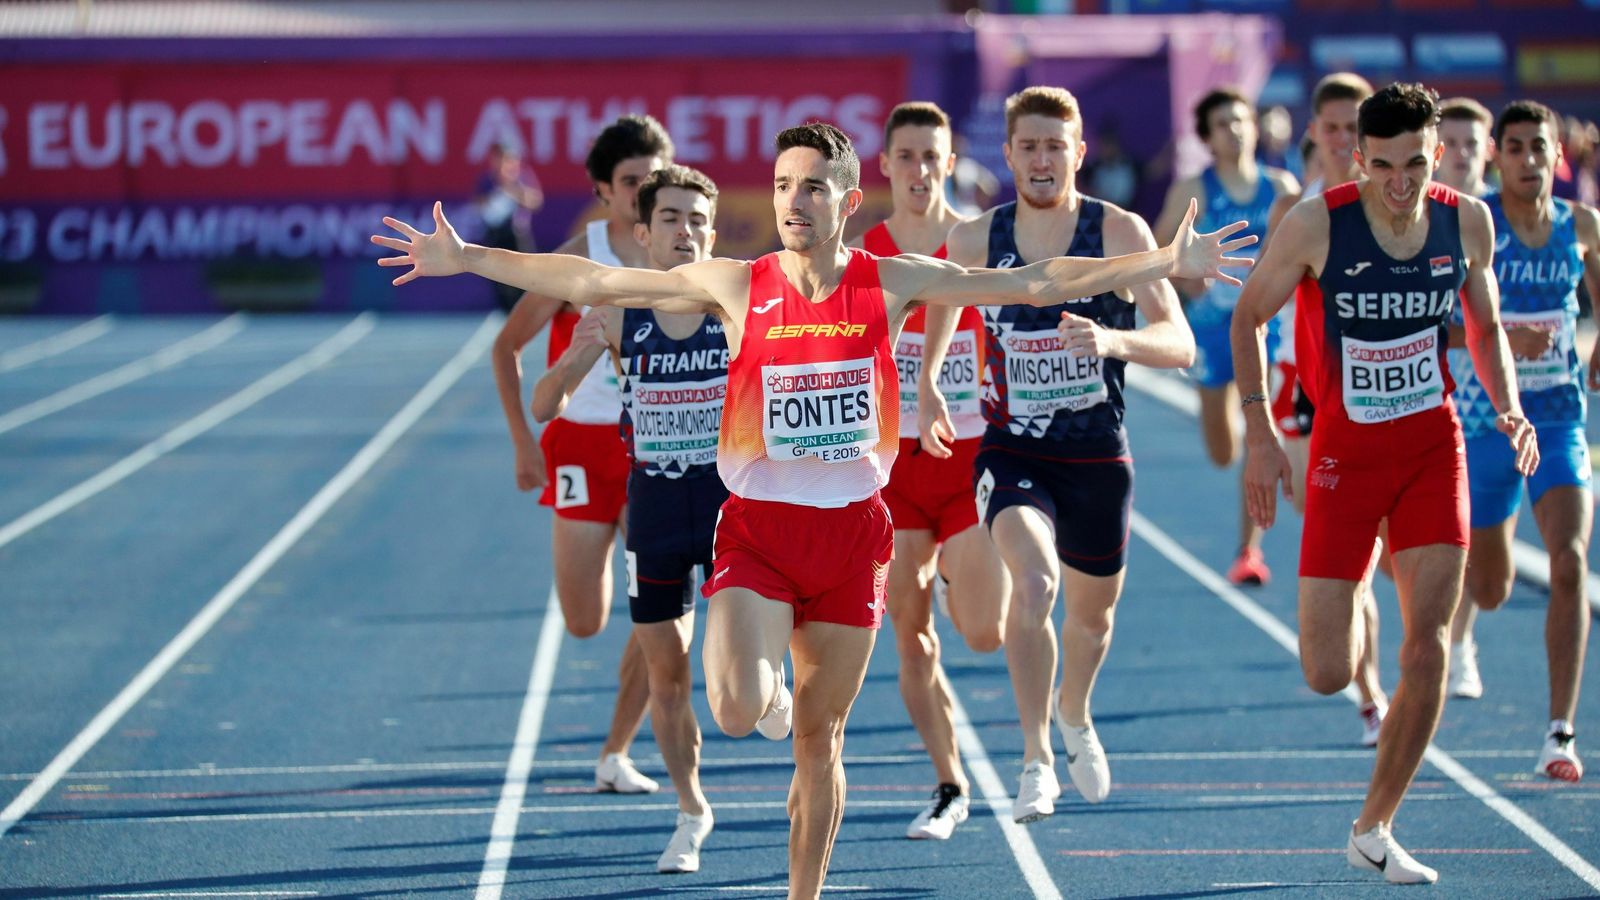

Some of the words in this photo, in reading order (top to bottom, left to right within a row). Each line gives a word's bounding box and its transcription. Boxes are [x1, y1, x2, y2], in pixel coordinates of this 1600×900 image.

[28, 101, 446, 168] EUROPEAN
[466, 94, 882, 164] ATHETIS
[1499, 260, 1569, 283] ITALIA
[1335, 288, 1455, 320] SERBIA
[765, 321, 867, 340] ESPAÑA
[901, 341, 971, 357] BAUS
[1021, 338, 1064, 352] BAUH
[1360, 335, 1434, 362] BAUHAUS
[648, 348, 730, 375] FRANCE
[1009, 356, 1099, 384] MISCHLER
[1351, 356, 1433, 392] BIBIC
[783, 368, 871, 393] BAUHAUS
[1052, 387, 1084, 397] CLEAN
[648, 385, 726, 405] BAUHAUS
[635, 406, 723, 437] JOCTEUR-MONROZI
[769, 390, 871, 429] FONTES
[660, 441, 681, 451] RUN
[682, 438, 714, 448] CLEAN
[794, 437, 818, 447] RUN
[819, 433, 855, 444] CLEAN
[833, 446, 860, 460] 2019
[561, 474, 577, 500] 2
